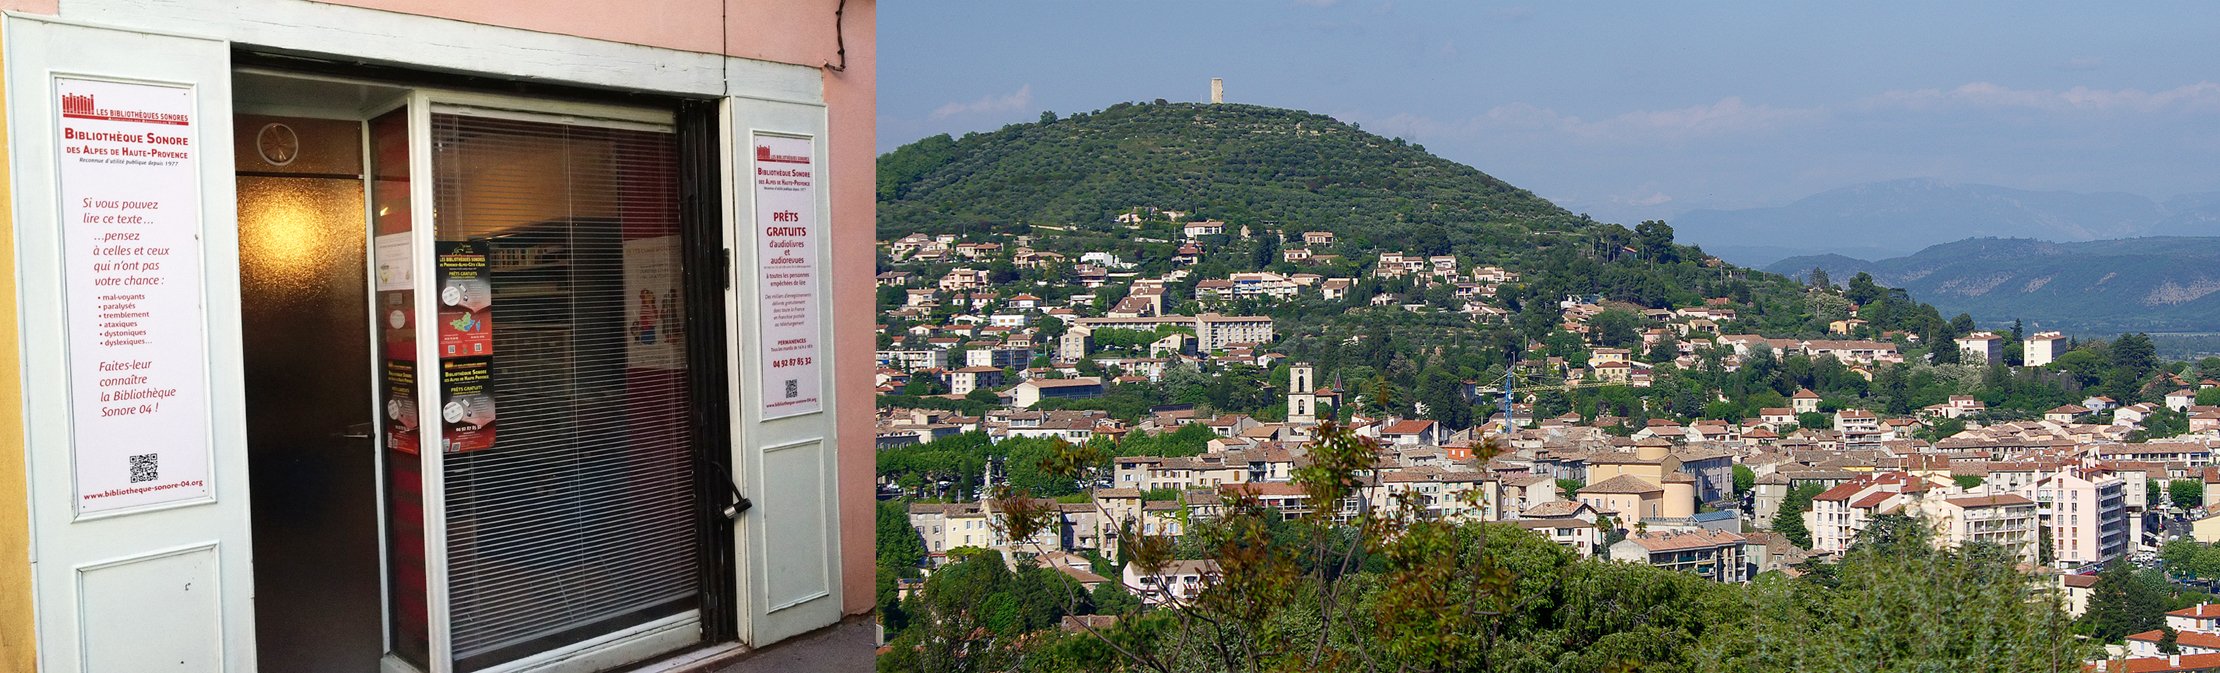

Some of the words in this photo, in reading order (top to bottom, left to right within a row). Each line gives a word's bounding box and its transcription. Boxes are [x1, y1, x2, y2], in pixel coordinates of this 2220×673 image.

[110, 110, 159, 119] BIBLIOTHÈQUES
[160, 113, 188, 121] SONORES
[64, 127, 143, 143] BIBLIOTHÈQUE
[147, 132, 188, 146] SONORE
[66, 146, 80, 154] DES
[83, 145, 108, 155] ALPES
[122, 147, 188, 159] HAUTE-PROVENCE
[83, 197, 92, 208] Si
[95, 200, 119, 208] vous
[122, 200, 159, 211] pouvez
[83, 212, 100, 223] lire
[102, 215, 114, 224] ce
[773, 209, 799, 222] PRÊTS
[766, 226, 807, 237] GRATUITS
[93, 245, 100, 255] à
[103, 245, 131, 255] celles
[134, 246, 143, 255] et
[147, 247, 170, 255] ceux
[93, 260, 111, 273] qui
[142, 262, 160, 273] pas
[95, 276, 121, 286] votre
[124, 275, 160, 285] chance
[103, 302, 136, 311] paralysés
[103, 311, 150, 319] tremblement
[104, 321, 138, 329] ataxiques
[104, 329, 147, 338] dystoniques
[99, 359, 152, 372] Faites-leur
[773, 360, 780, 368] 04
[99, 374, 148, 387] connaître
[100, 391, 110, 402] la
[113, 387, 177, 401] Bibliothèque
[101, 406, 136, 417] Sonore
[139, 404, 152, 414] 04
[155, 402, 159, 412] !
[83, 480, 204, 500] www.bibliotheque-sonore-04.org
